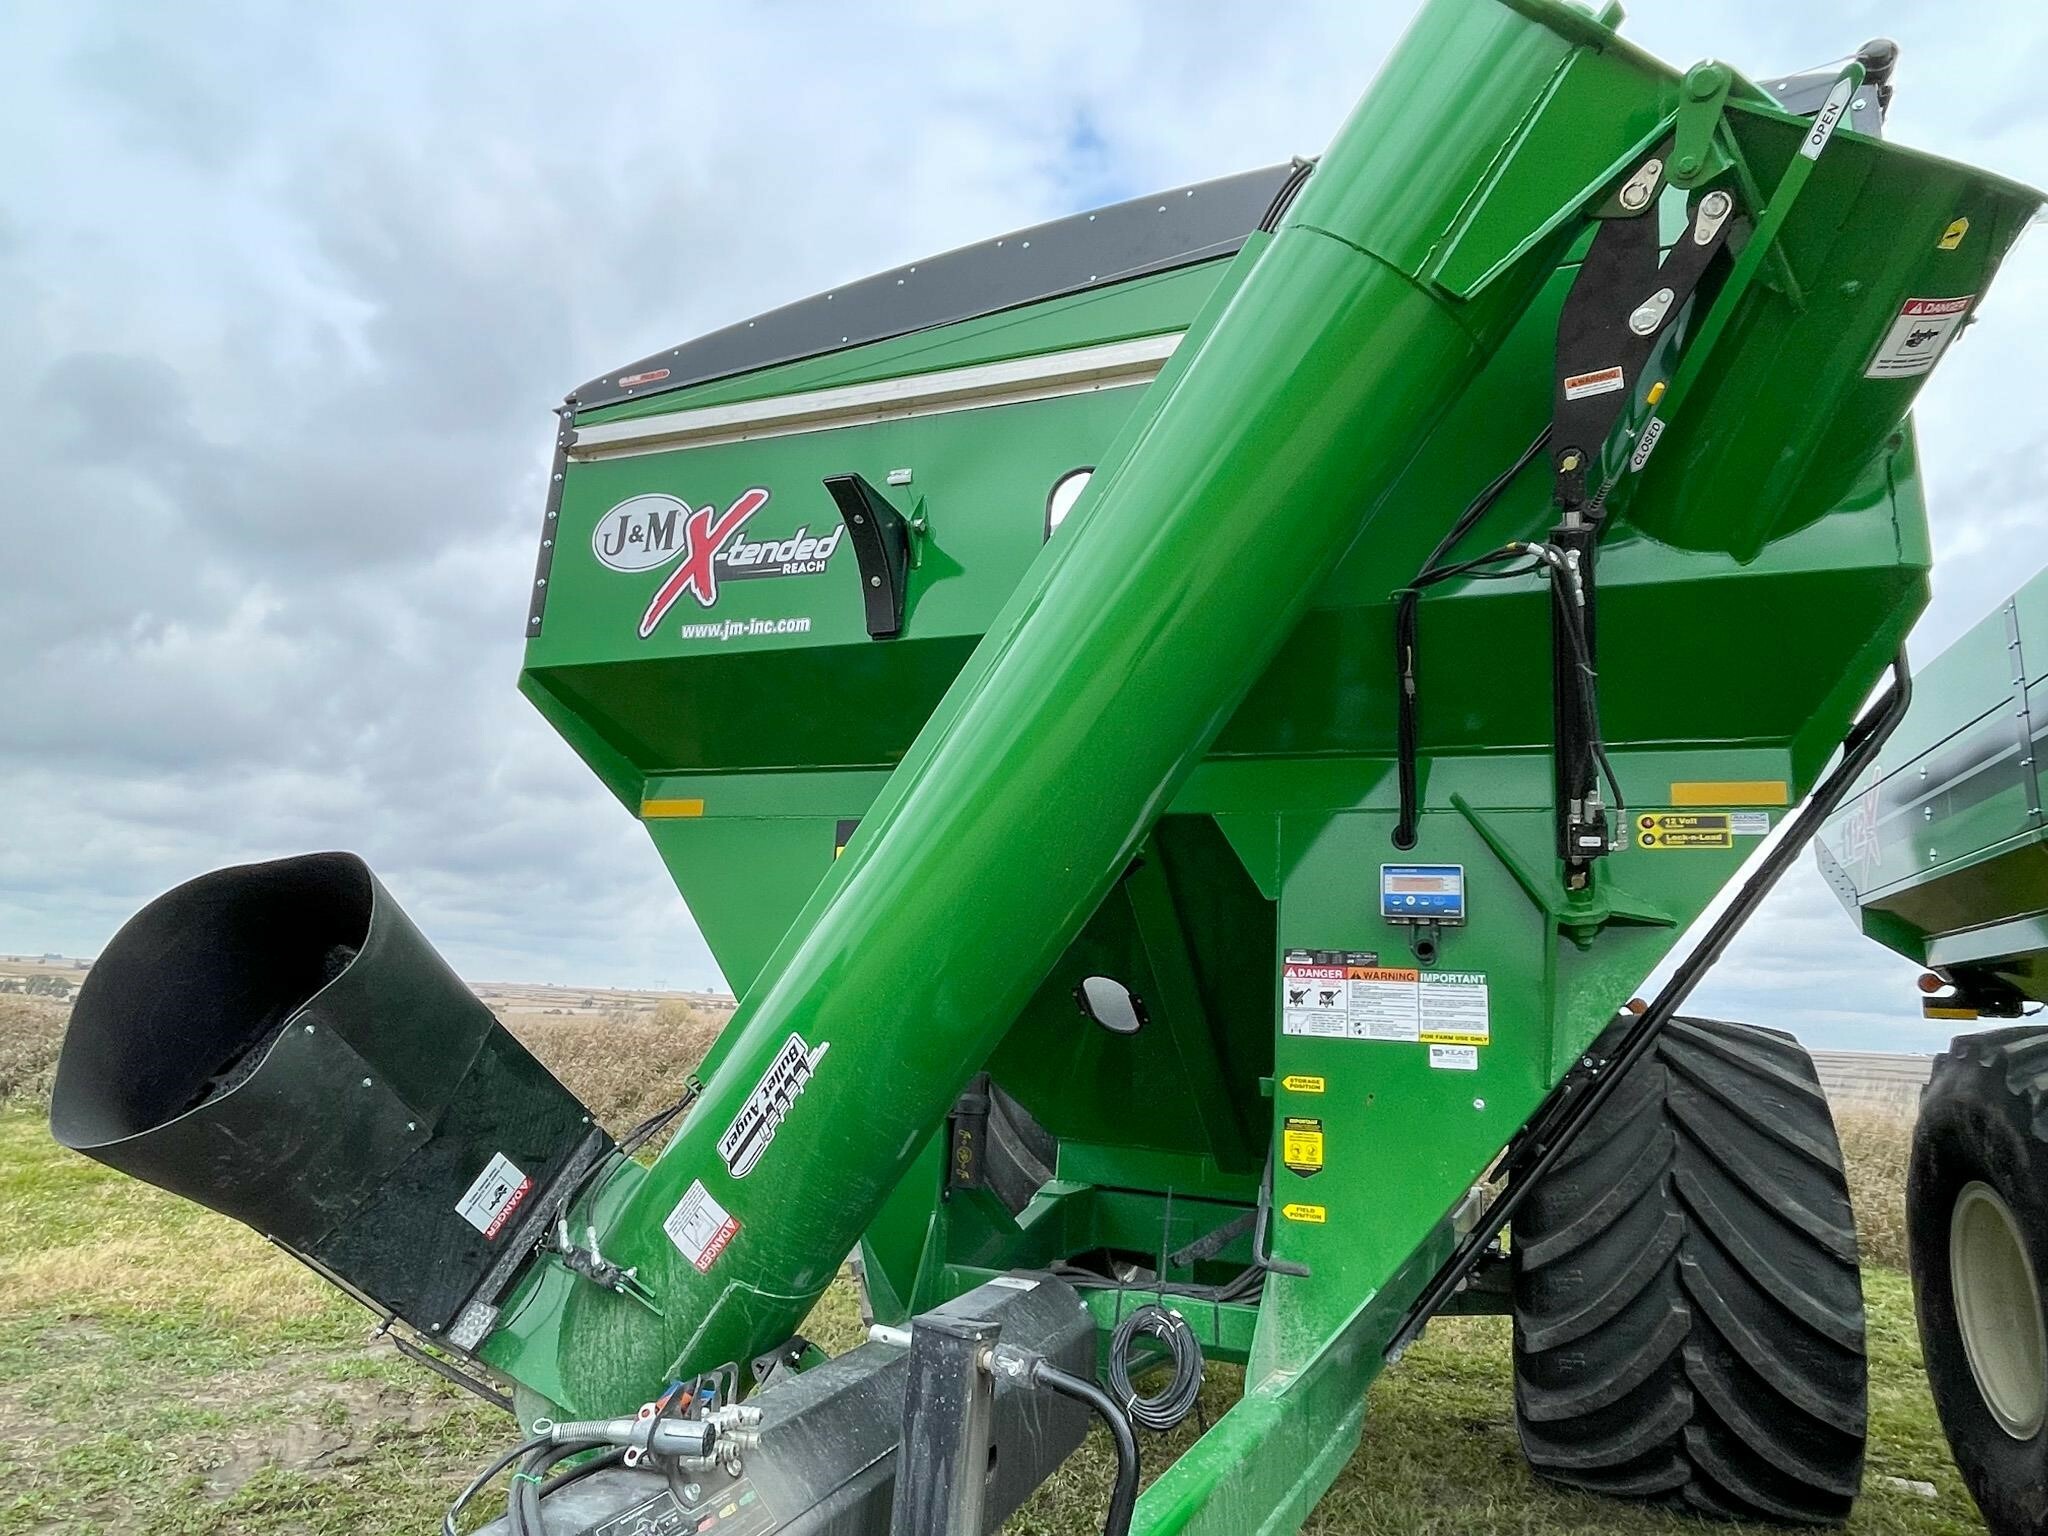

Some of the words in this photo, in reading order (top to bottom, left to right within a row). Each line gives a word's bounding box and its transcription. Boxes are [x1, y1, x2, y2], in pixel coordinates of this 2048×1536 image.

[1811, 103, 1840, 145] OPEN
[1924, 301, 1968, 314] DANGER
[1634, 422, 1661, 465] CLOSED
[603, 510, 679, 556] J&M
[782, 560, 825, 575] REACH
[682, 617, 811, 640] www.jm-inc.com
[1297, 968, 1343, 979] DANGER
[1363, 971, 1415, 981] WARNING
[1420, 973, 1486, 984] IMPORTANT
[762, 1044, 800, 1099] Bullet
[725, 1098, 760, 1155] Auger
[486, 1192, 523, 1237] DANGER
[697, 1227, 733, 1270] DANGER
